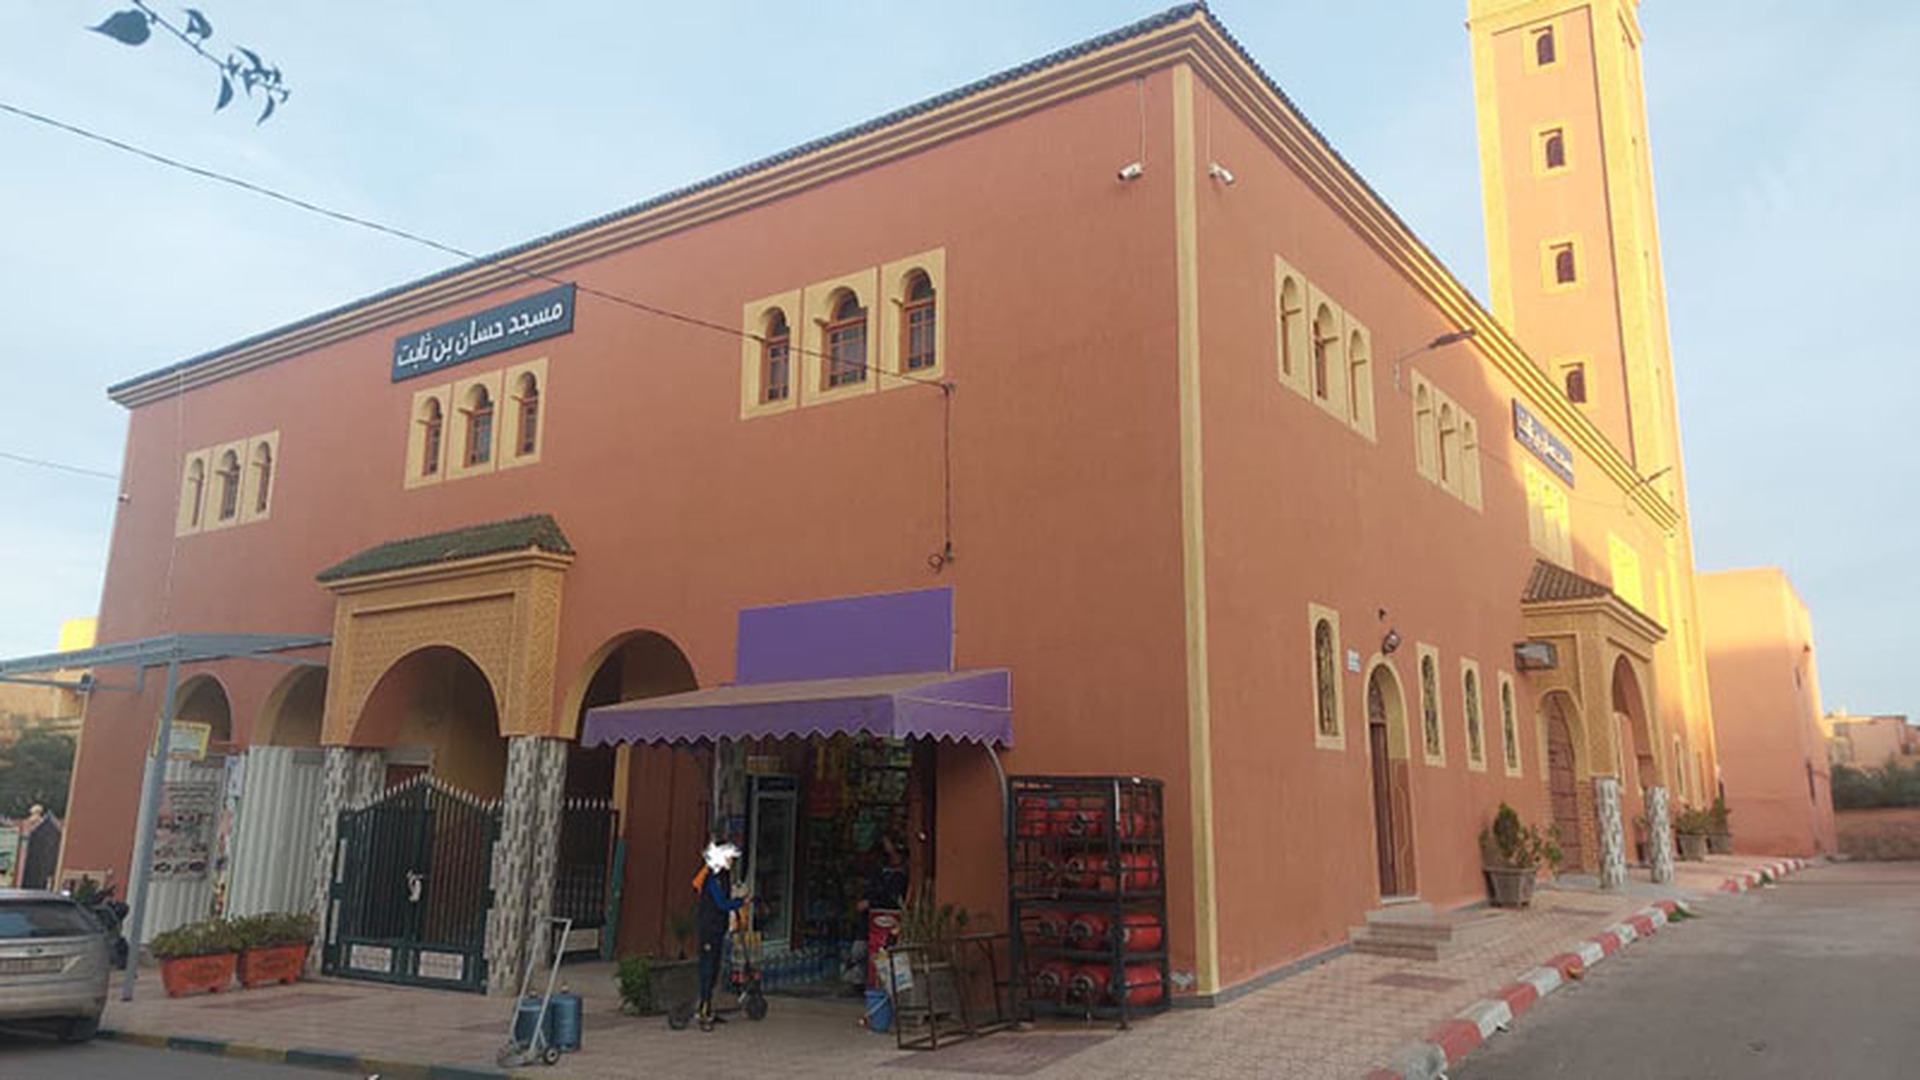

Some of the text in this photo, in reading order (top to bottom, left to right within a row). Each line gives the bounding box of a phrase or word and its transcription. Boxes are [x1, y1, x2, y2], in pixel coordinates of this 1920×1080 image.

[397, 302, 563, 370] مسجد حسان بن ثابت
